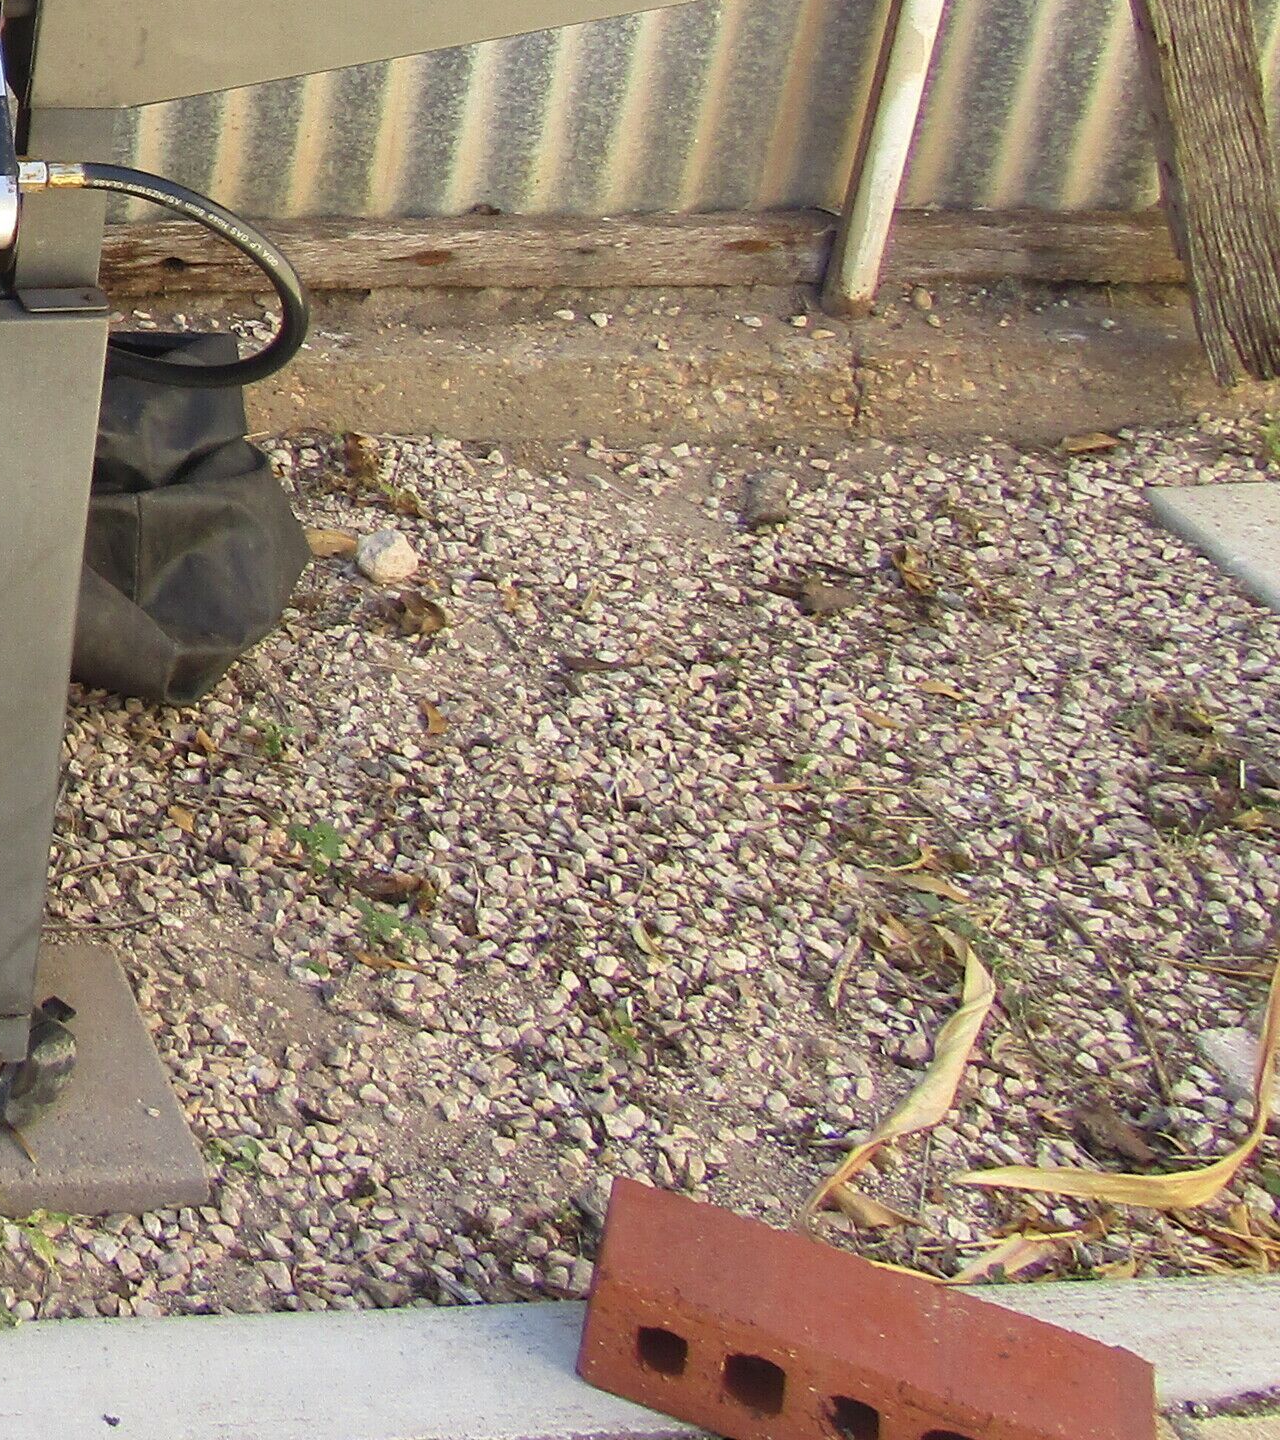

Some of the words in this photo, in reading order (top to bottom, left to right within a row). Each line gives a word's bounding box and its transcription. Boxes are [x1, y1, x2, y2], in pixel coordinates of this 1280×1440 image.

[208, 213, 229, 230] Hose
[230, 227, 249, 242] GAS
[250, 242, 262, 250] LP
